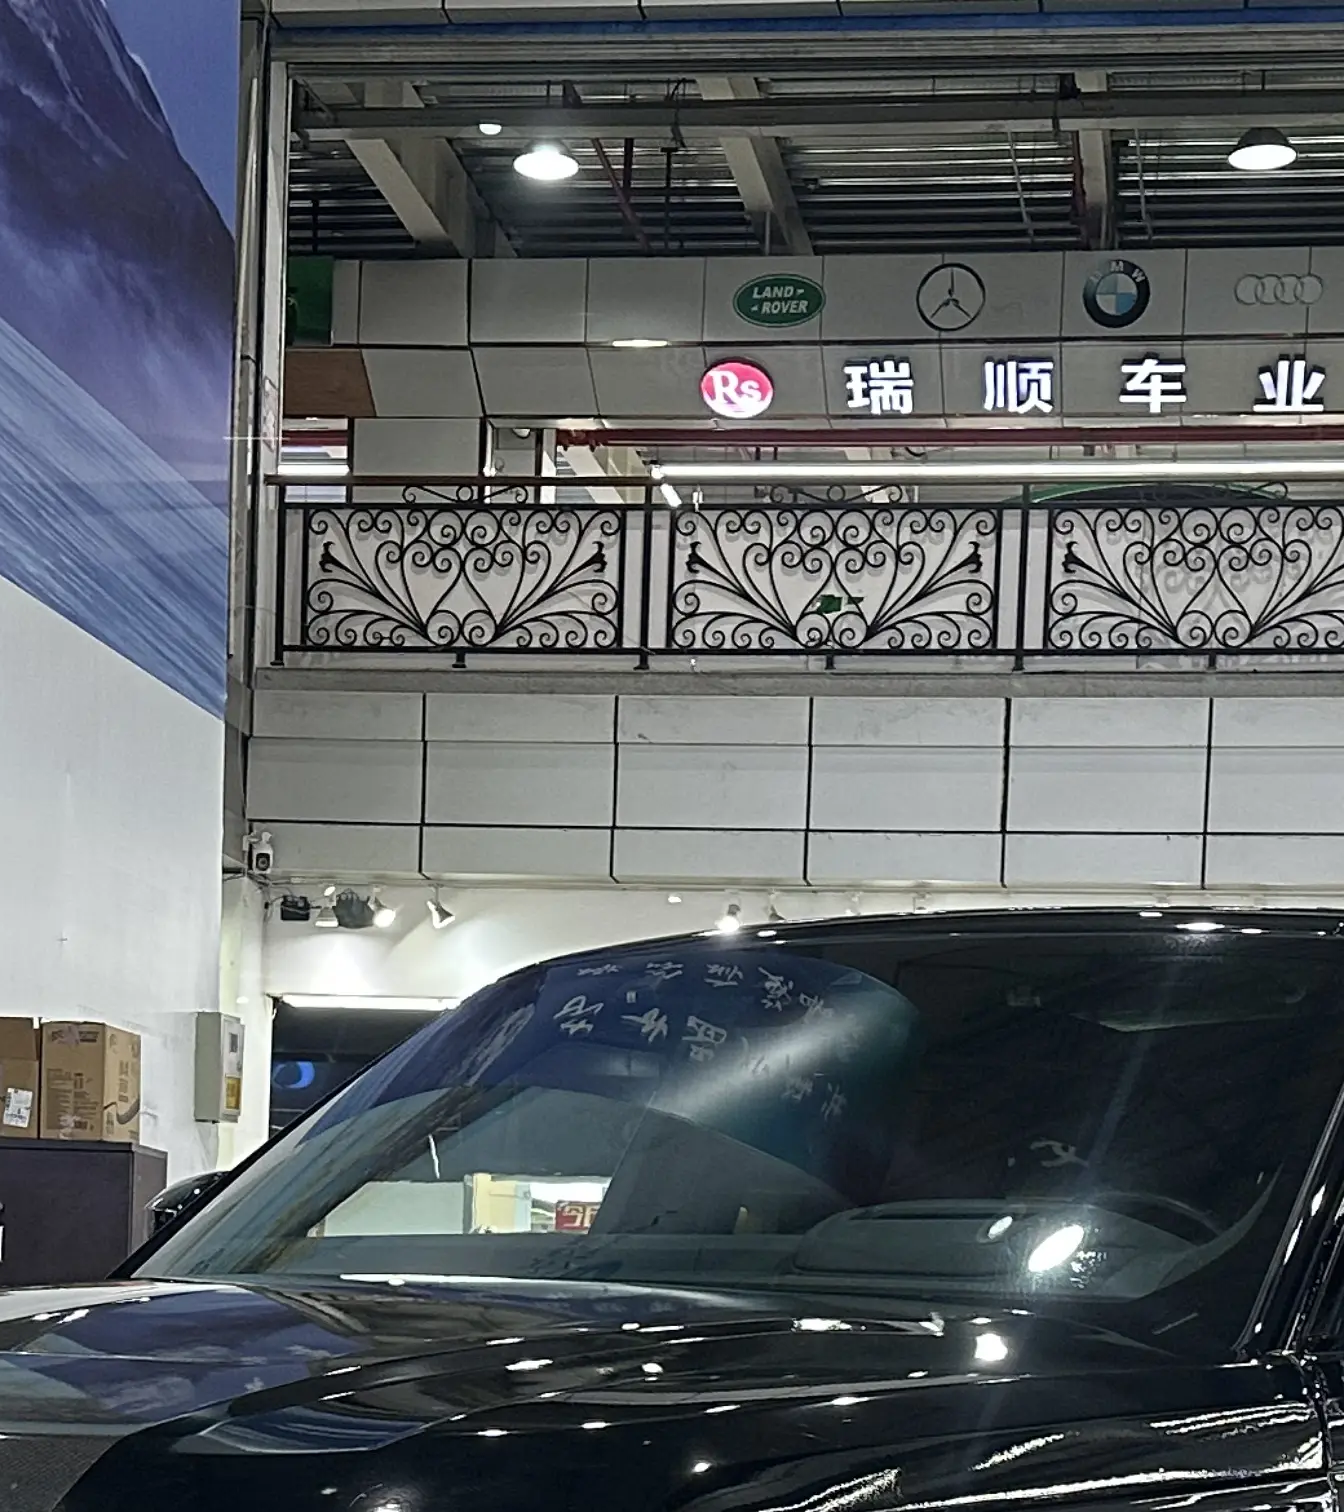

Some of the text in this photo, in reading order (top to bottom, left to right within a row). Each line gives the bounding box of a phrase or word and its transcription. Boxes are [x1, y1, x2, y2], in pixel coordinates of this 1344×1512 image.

[752, 286, 795, 299] LAND
[760, 300, 810, 315] ROVER
[845, 356, 1327, 416] 瑞顺车业
